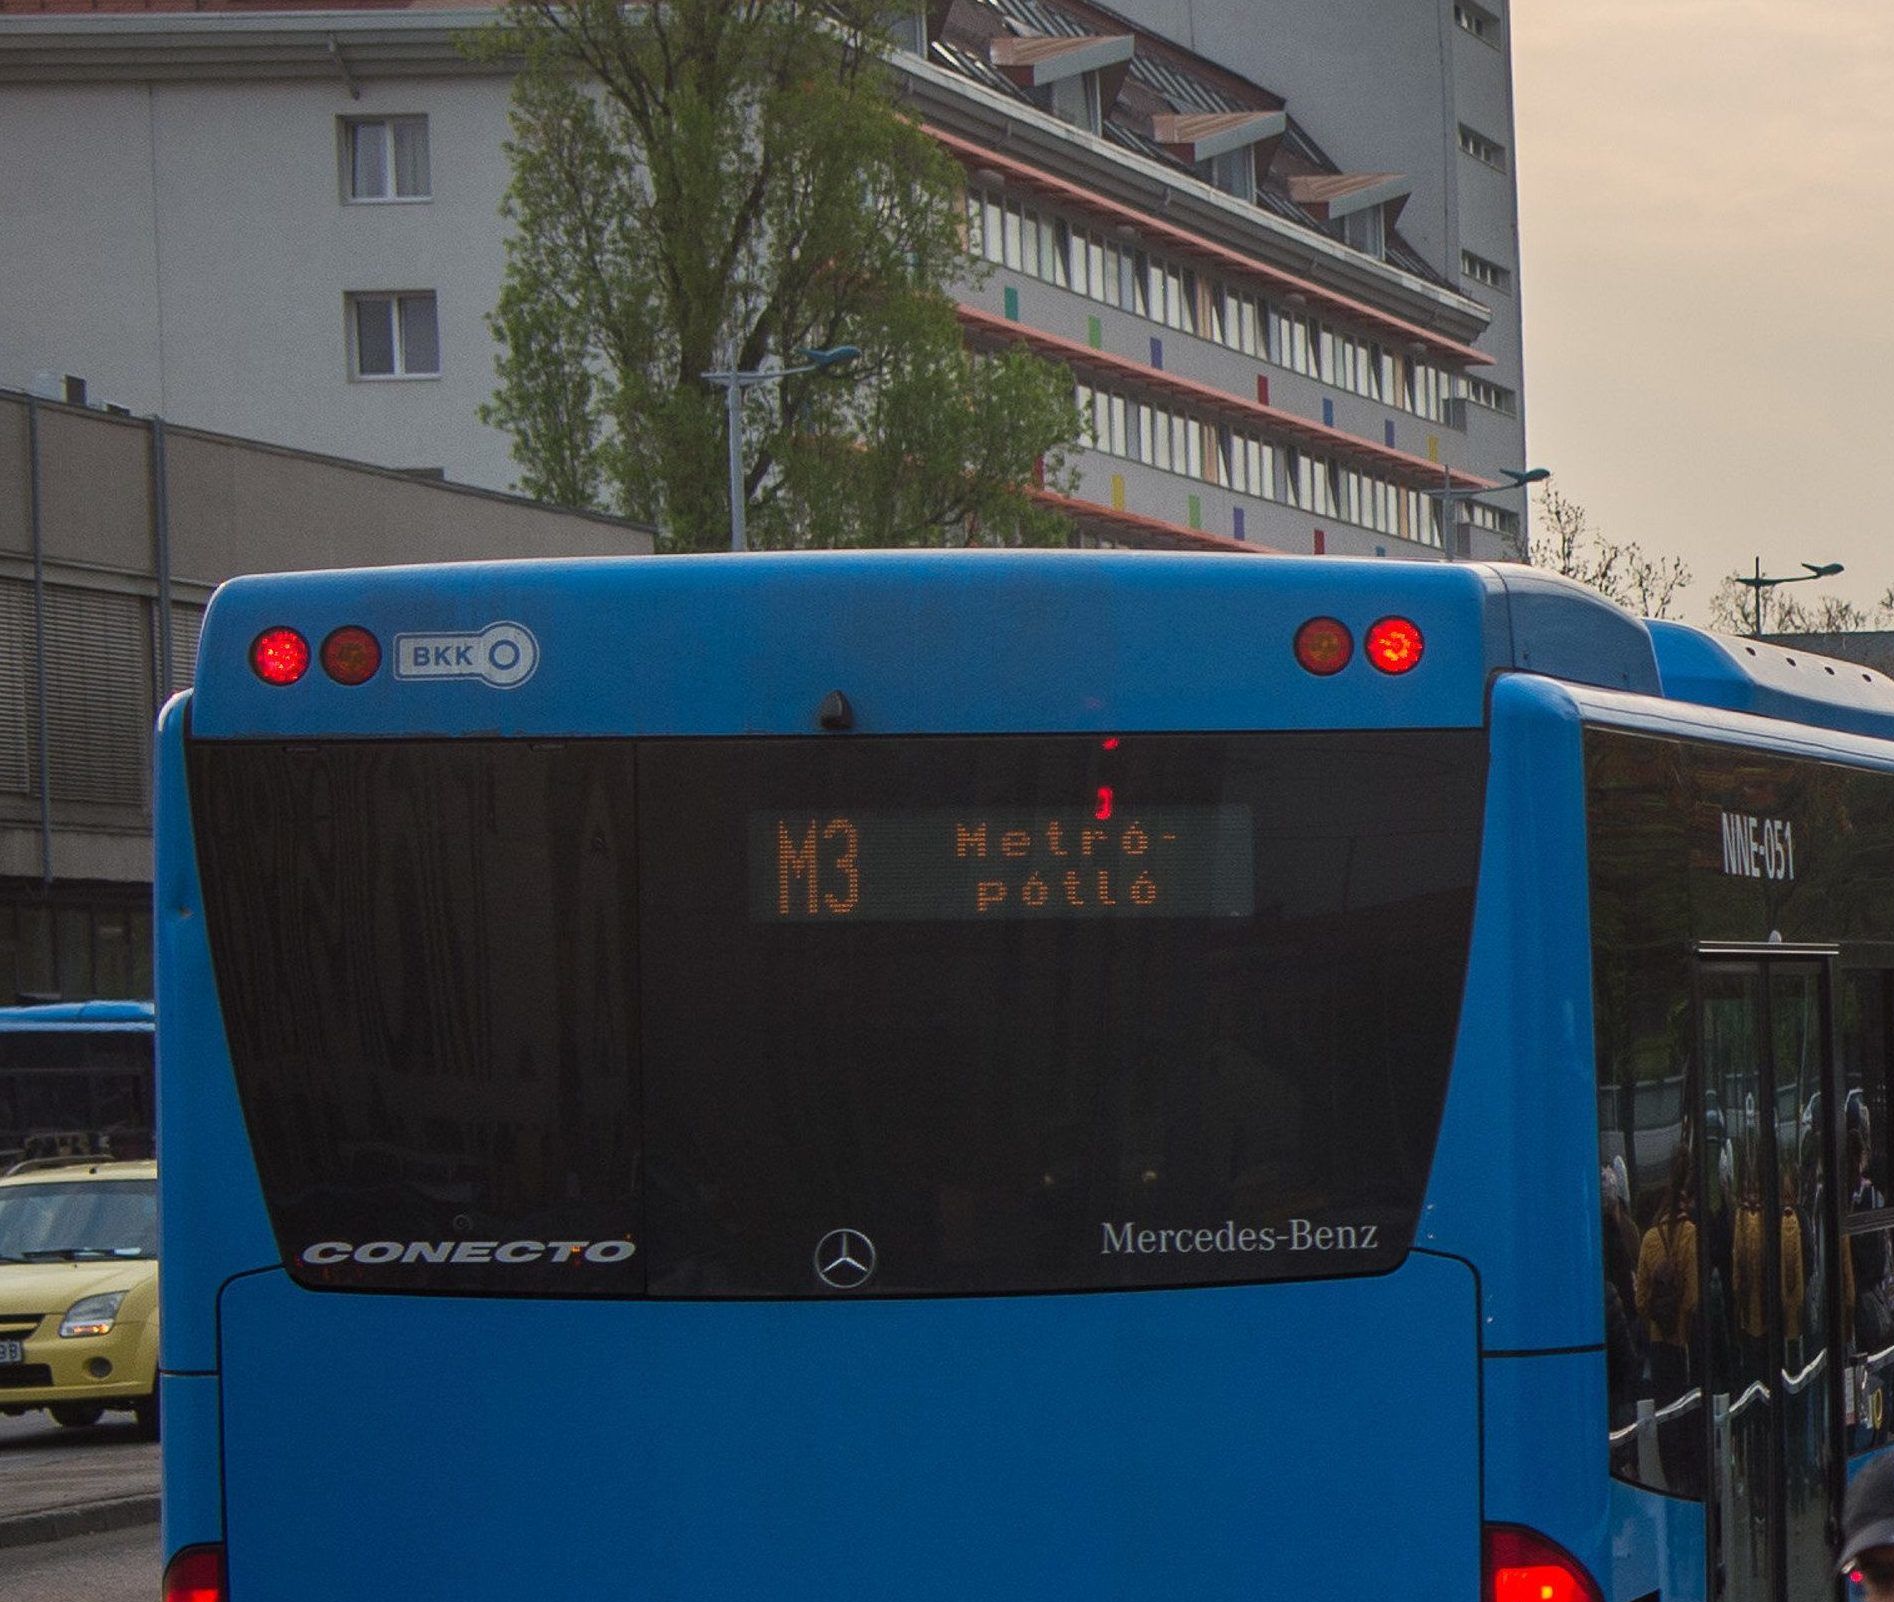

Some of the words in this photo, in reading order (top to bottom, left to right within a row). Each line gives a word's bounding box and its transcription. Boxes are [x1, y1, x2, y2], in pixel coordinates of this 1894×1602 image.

[413, 645, 473, 667] BKK
[955, 820, 1177, 858] Metró-
[1721, 811, 1795, 881] NNE-051
[777, 818, 860, 916] M3
[976, 870, 1158, 912] pótló
[302, 1240, 637, 1265] CONECTO
[1100, 1218, 1380, 1254] Mercedes-Benz
